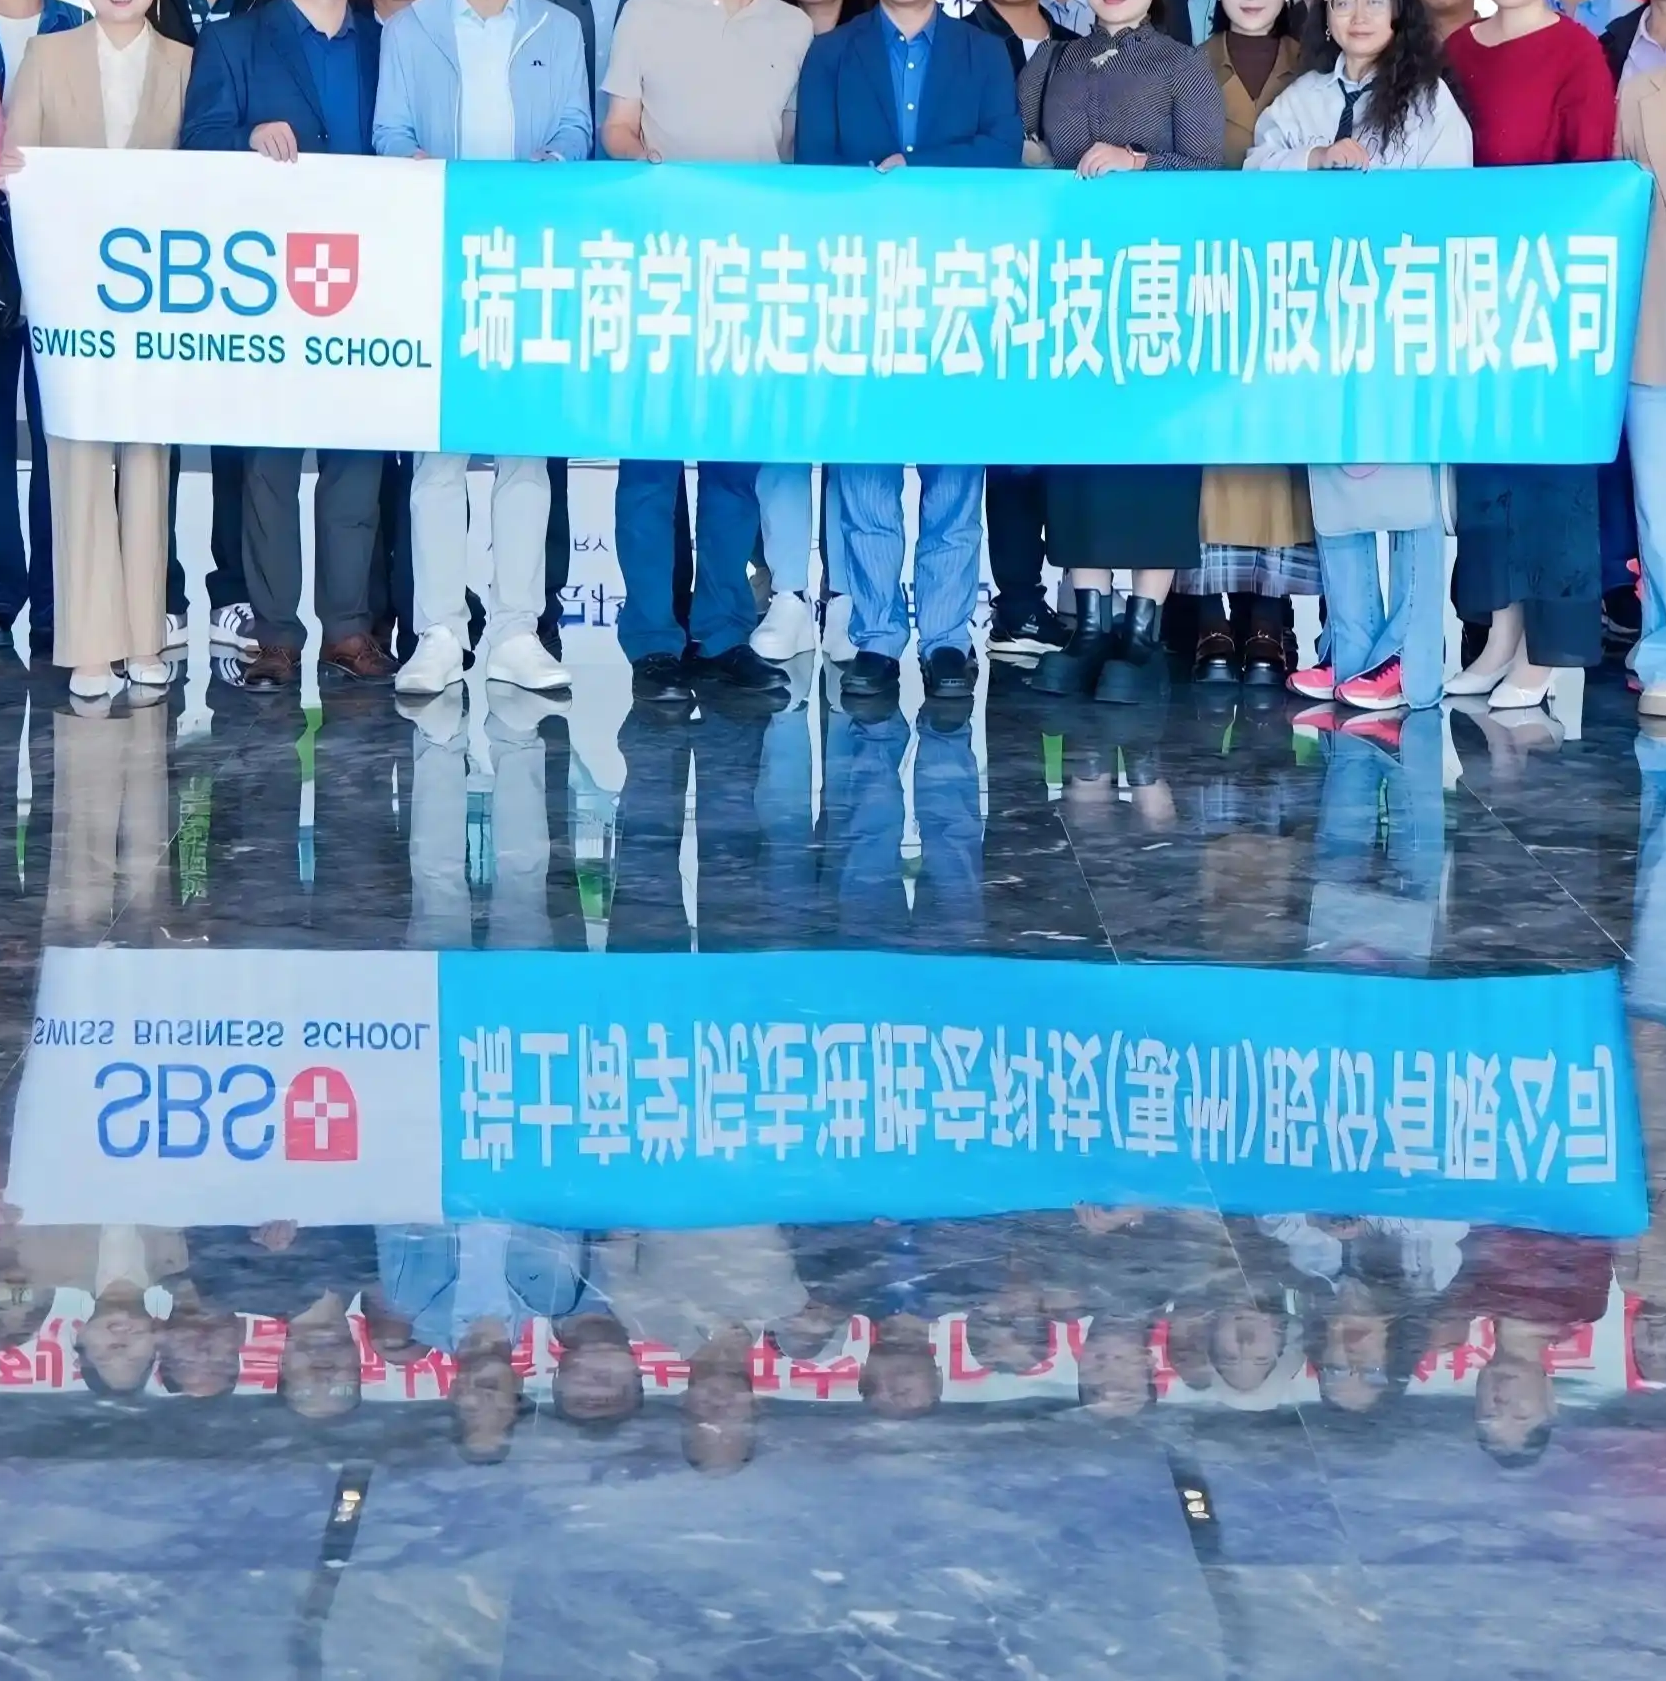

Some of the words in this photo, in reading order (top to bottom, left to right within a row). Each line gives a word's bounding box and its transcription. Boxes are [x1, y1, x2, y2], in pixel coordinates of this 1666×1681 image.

[98, 228, 276, 316] SBS
[461, 227, 1617, 384] 瑞士商学院走进胜宏科技(惠州)股份有限公司
[31, 326, 115, 359] SWISS
[137, 331, 285, 363] BUSINESS
[306, 337, 431, 367] SCHOOL
